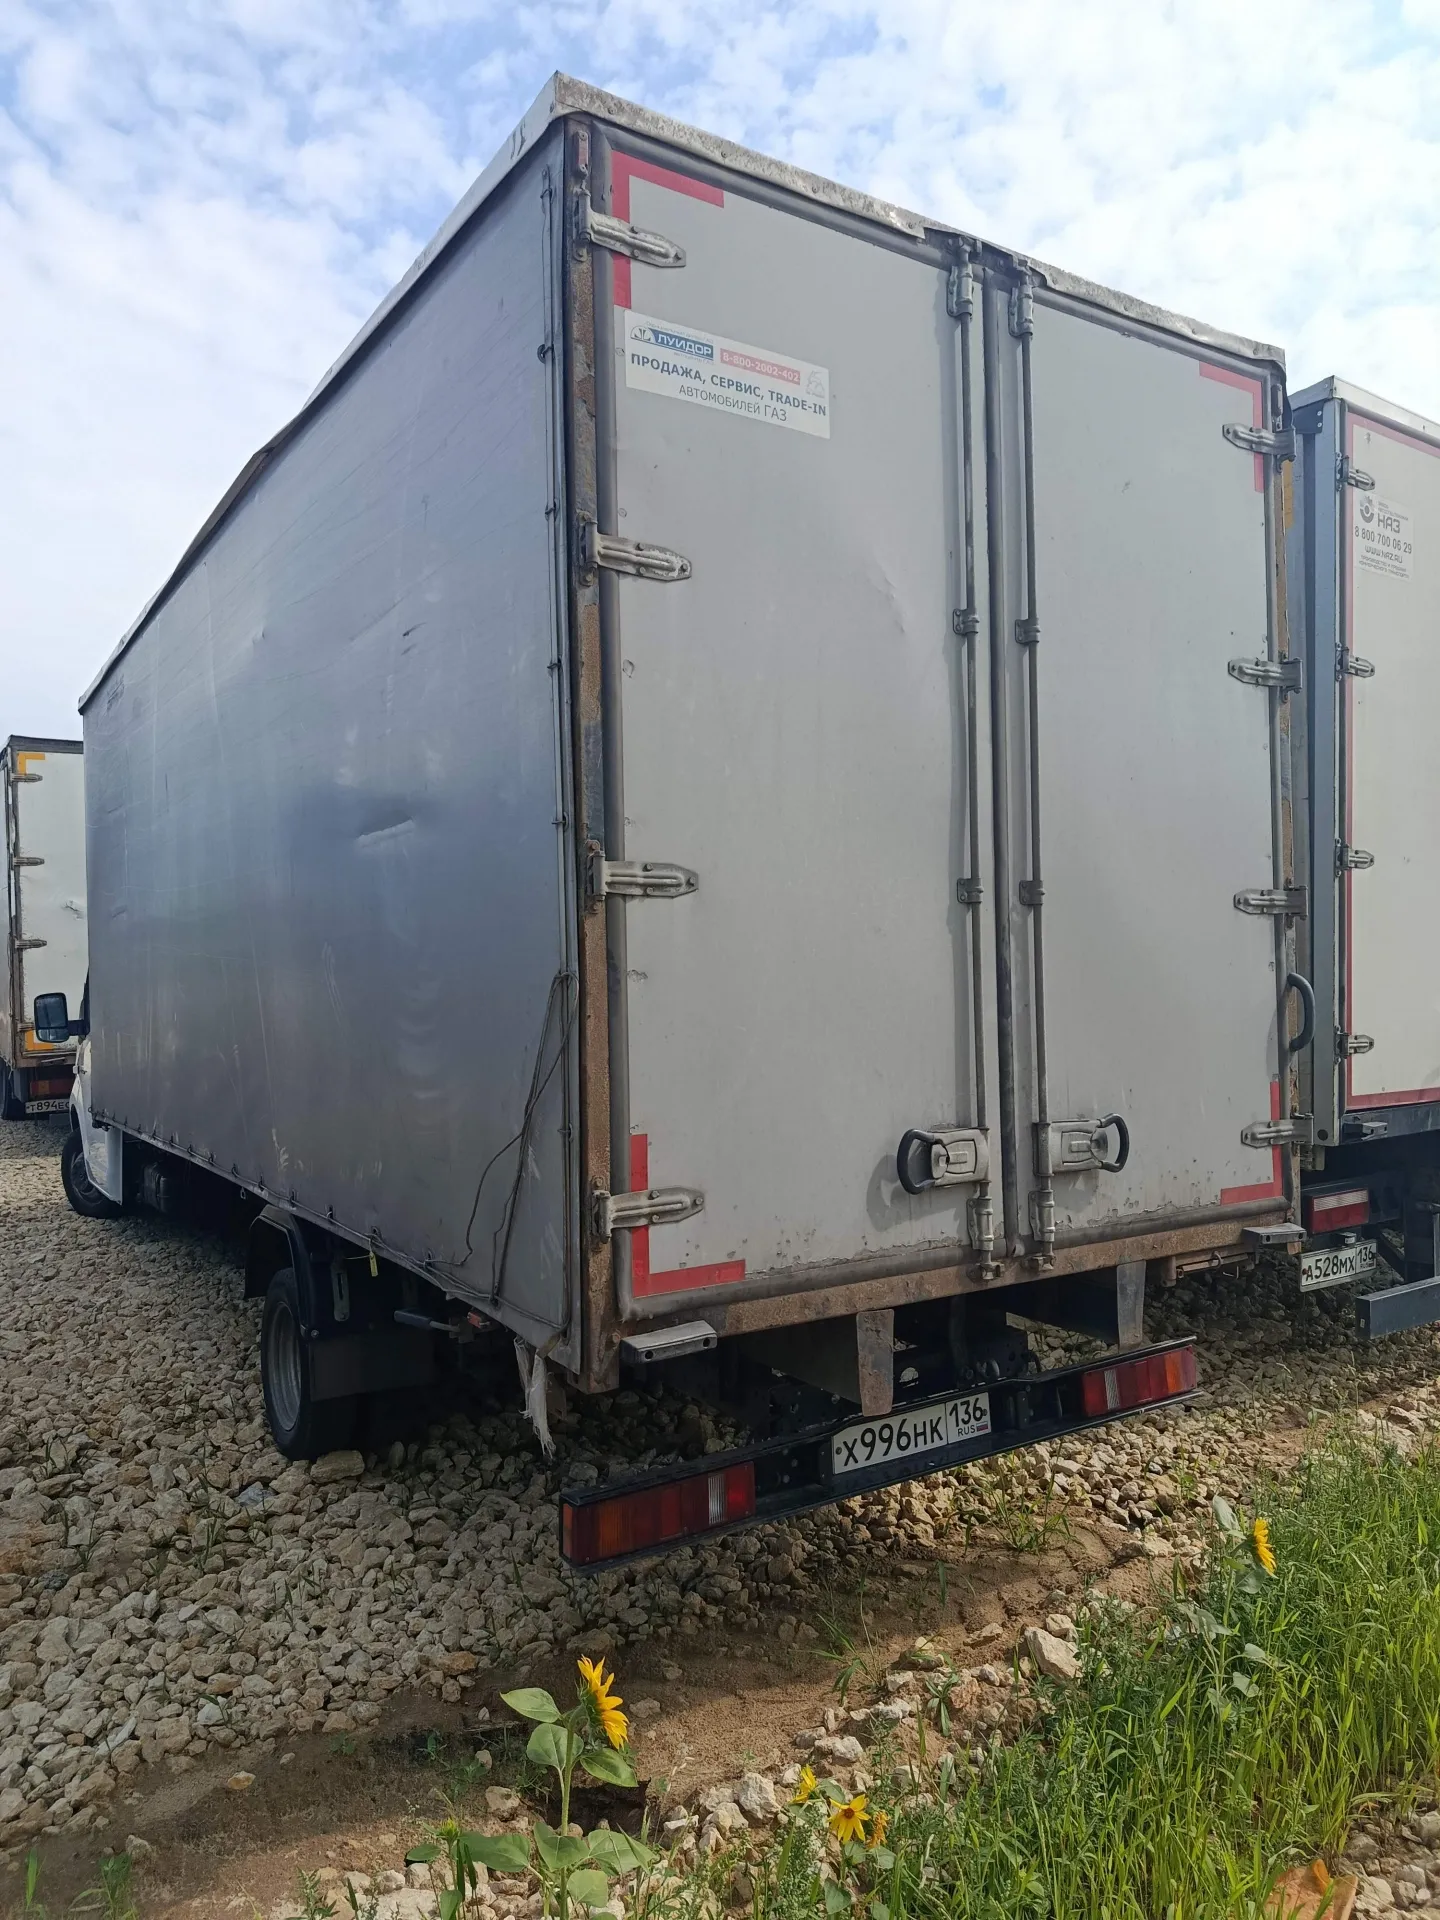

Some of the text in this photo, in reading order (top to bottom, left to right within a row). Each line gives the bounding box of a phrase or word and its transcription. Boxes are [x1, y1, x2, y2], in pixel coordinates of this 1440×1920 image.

[657, 333, 712, 356] ЛУИДОР
[631, 353, 706, 384] ПРОДАЖА,
[710, 374, 764, 400] СЕРВИС,
[768, 390, 826, 416] TRADE-IN
[678, 384, 787, 421] АВТОМОБИЛЕЙ ГАЗ
[1377, 512, 1400, 533] НАЗ
[1354, 525, 1360, 537] 8
[1361, 528, 1375, 543] 800
[1377, 533, 1390, 548] 700
[1403, 542, 1412, 554] 29
[1305, 1255, 1355, 1281] А528МХ
[842, 1397, 984, 1466] Х996НК 136
[957, 1424, 976, 1437] RUS
